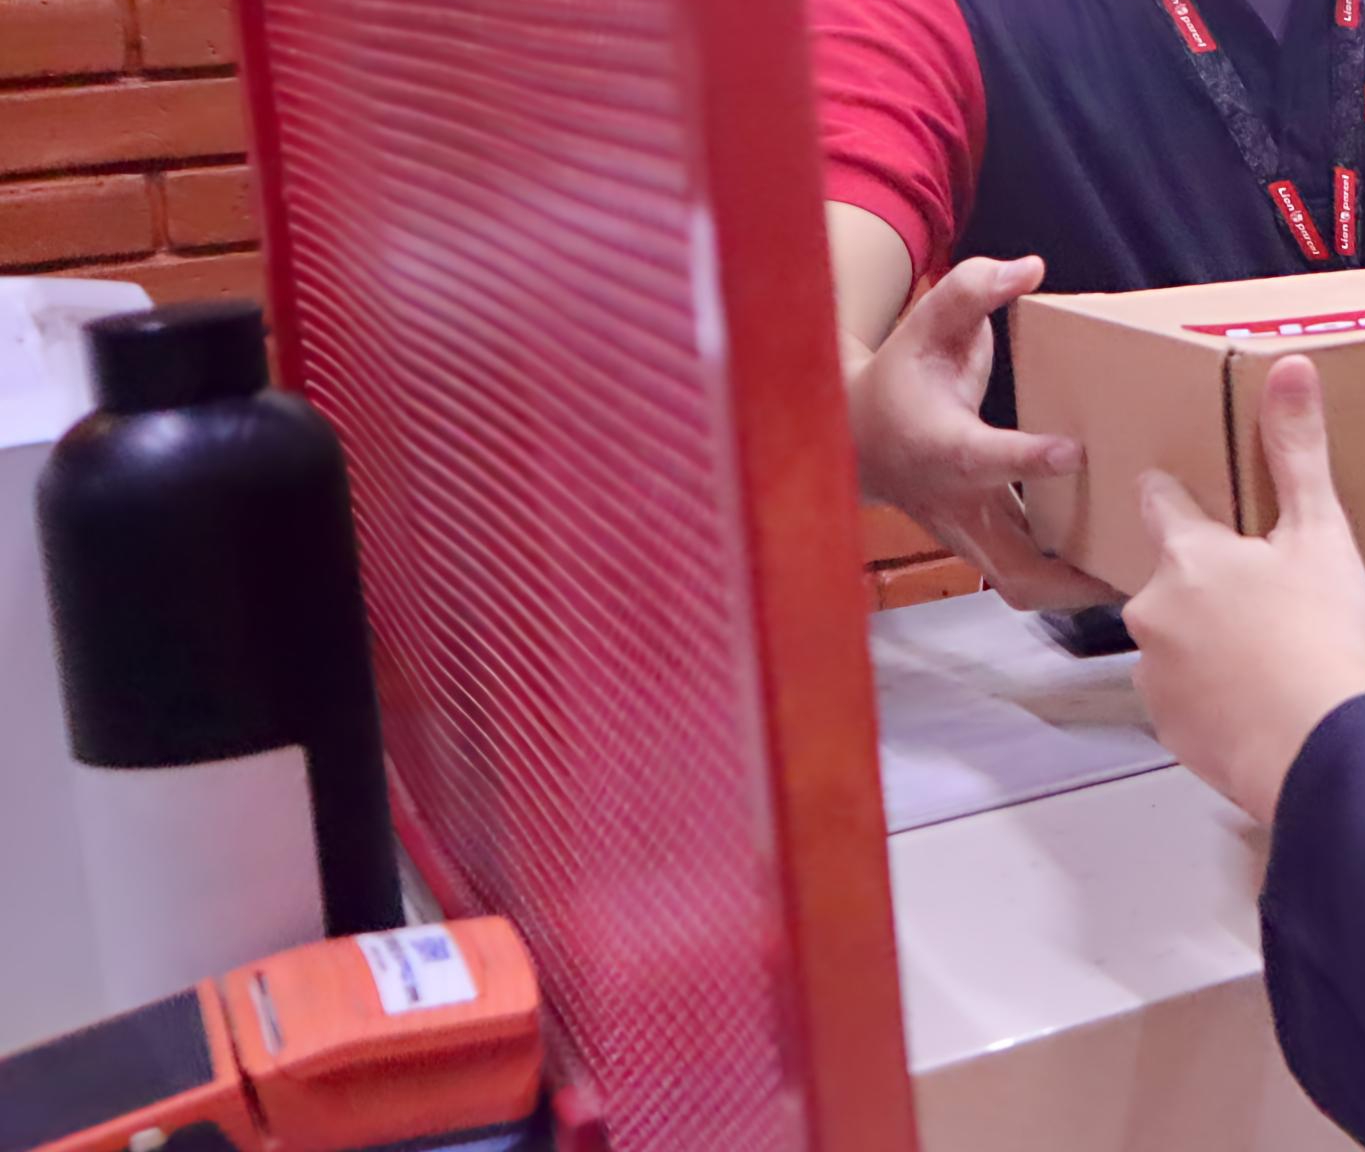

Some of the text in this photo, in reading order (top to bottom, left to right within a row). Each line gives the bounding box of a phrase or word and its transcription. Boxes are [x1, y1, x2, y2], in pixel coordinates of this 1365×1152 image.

[1180, 15, 1207, 47] parcel
[1278, 187, 1320, 255] Lion parcel
[1341, 174, 1351, 249] Lion parcel
